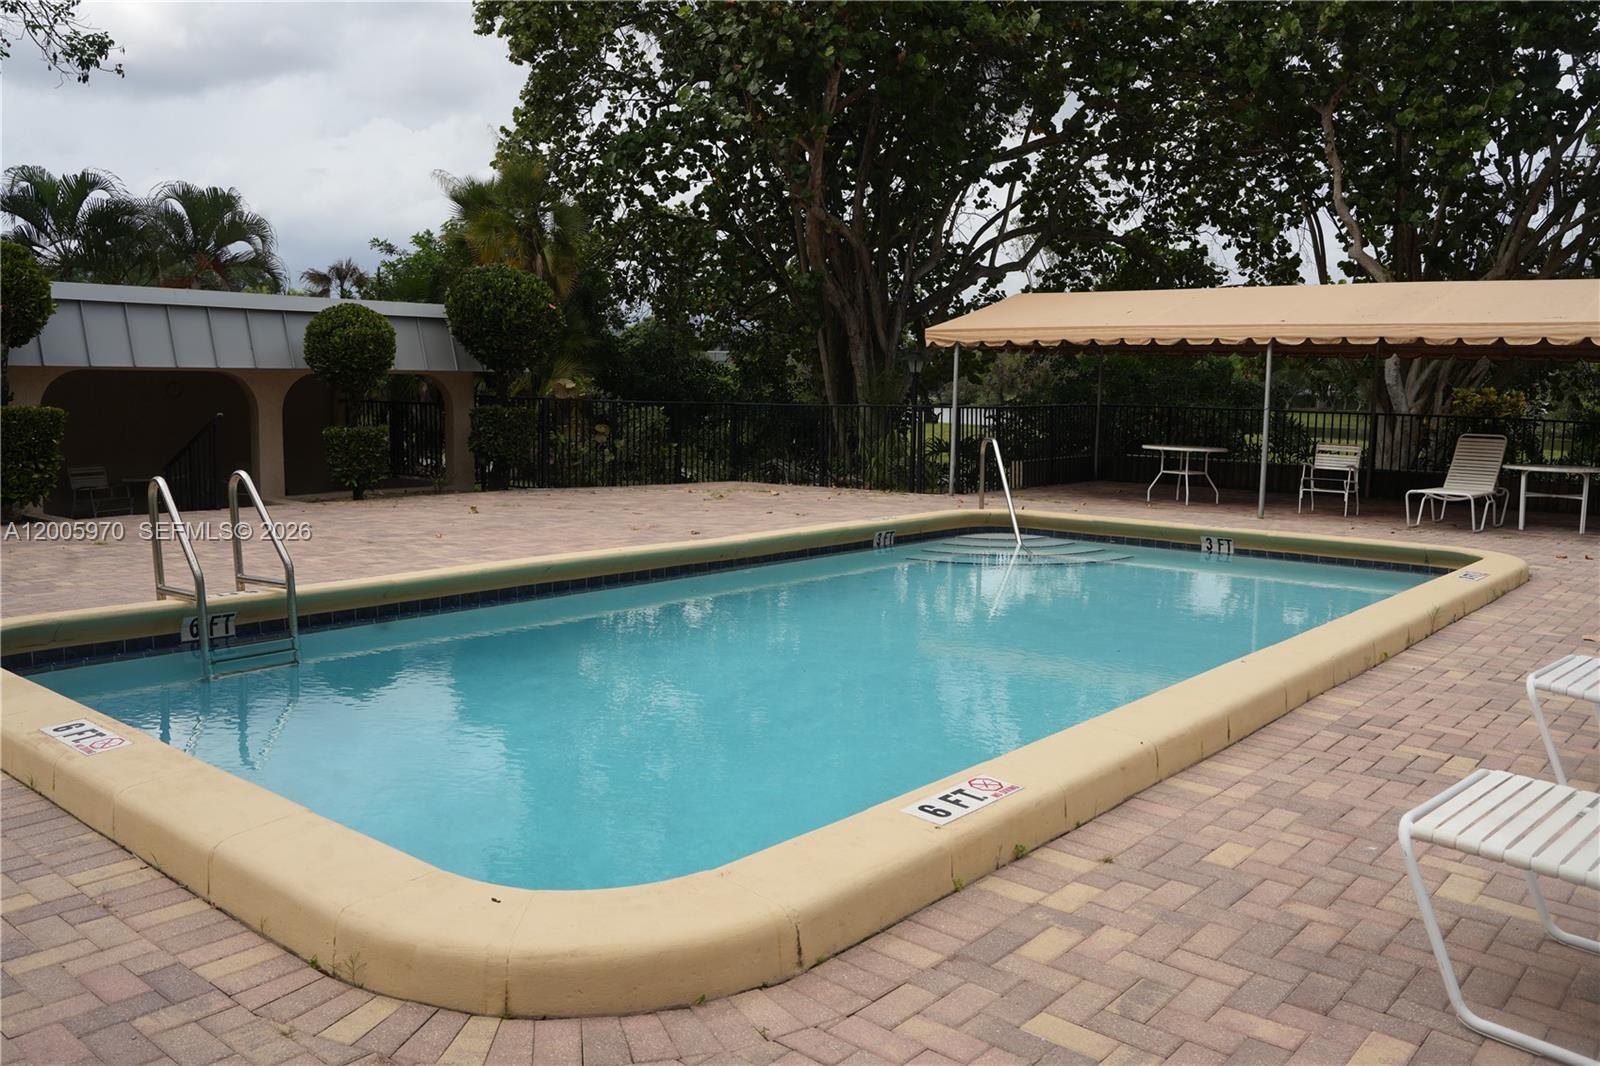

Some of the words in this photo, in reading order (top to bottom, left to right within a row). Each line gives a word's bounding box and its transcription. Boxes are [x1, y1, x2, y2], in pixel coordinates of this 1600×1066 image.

[1205, 537, 1213, 551] 3
[1217, 538, 1233, 553] FT
[189, 617, 200, 638] 6
[209, 613, 235, 636] FT
[52, 722, 86, 733] 6
[918, 804, 952, 818] 6
